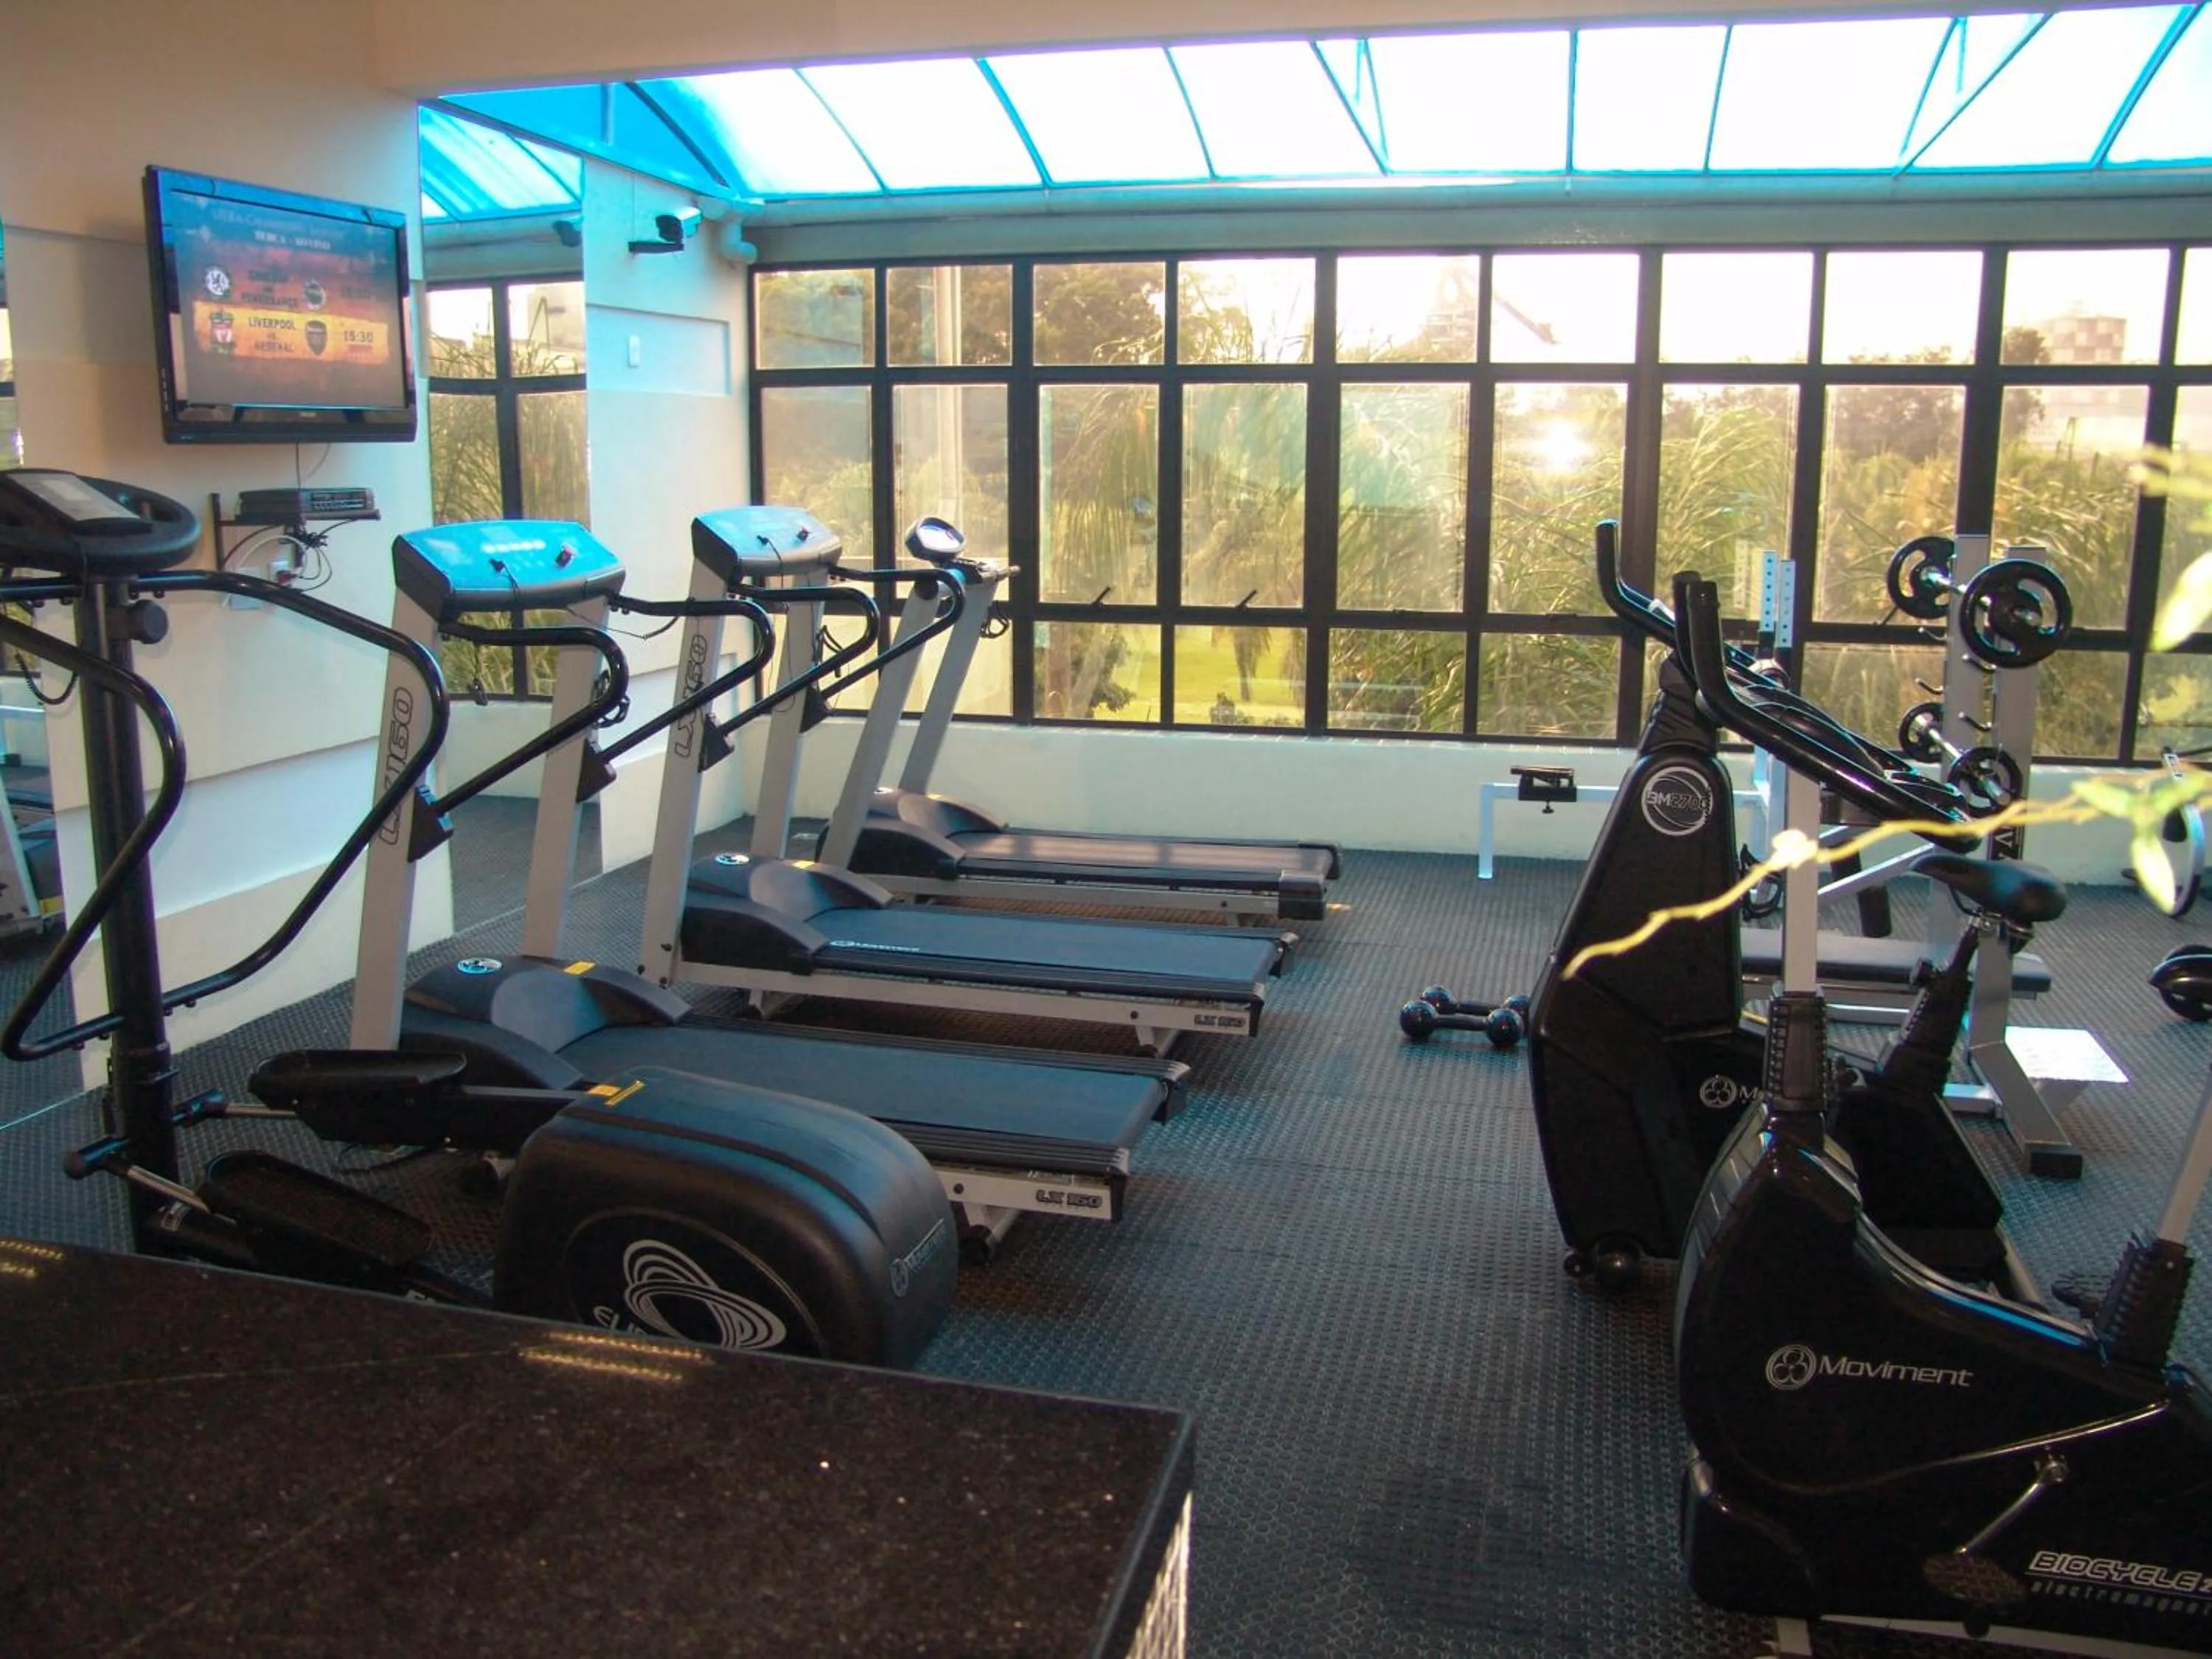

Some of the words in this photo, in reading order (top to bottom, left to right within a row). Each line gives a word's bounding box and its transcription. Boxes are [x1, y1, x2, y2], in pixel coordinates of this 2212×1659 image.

[248, 317, 296, 331] LIVERPOOL
[1818, 1355, 1975, 1387] Moviment
[2029, 1551, 2202, 1593] BIOCYCLE
